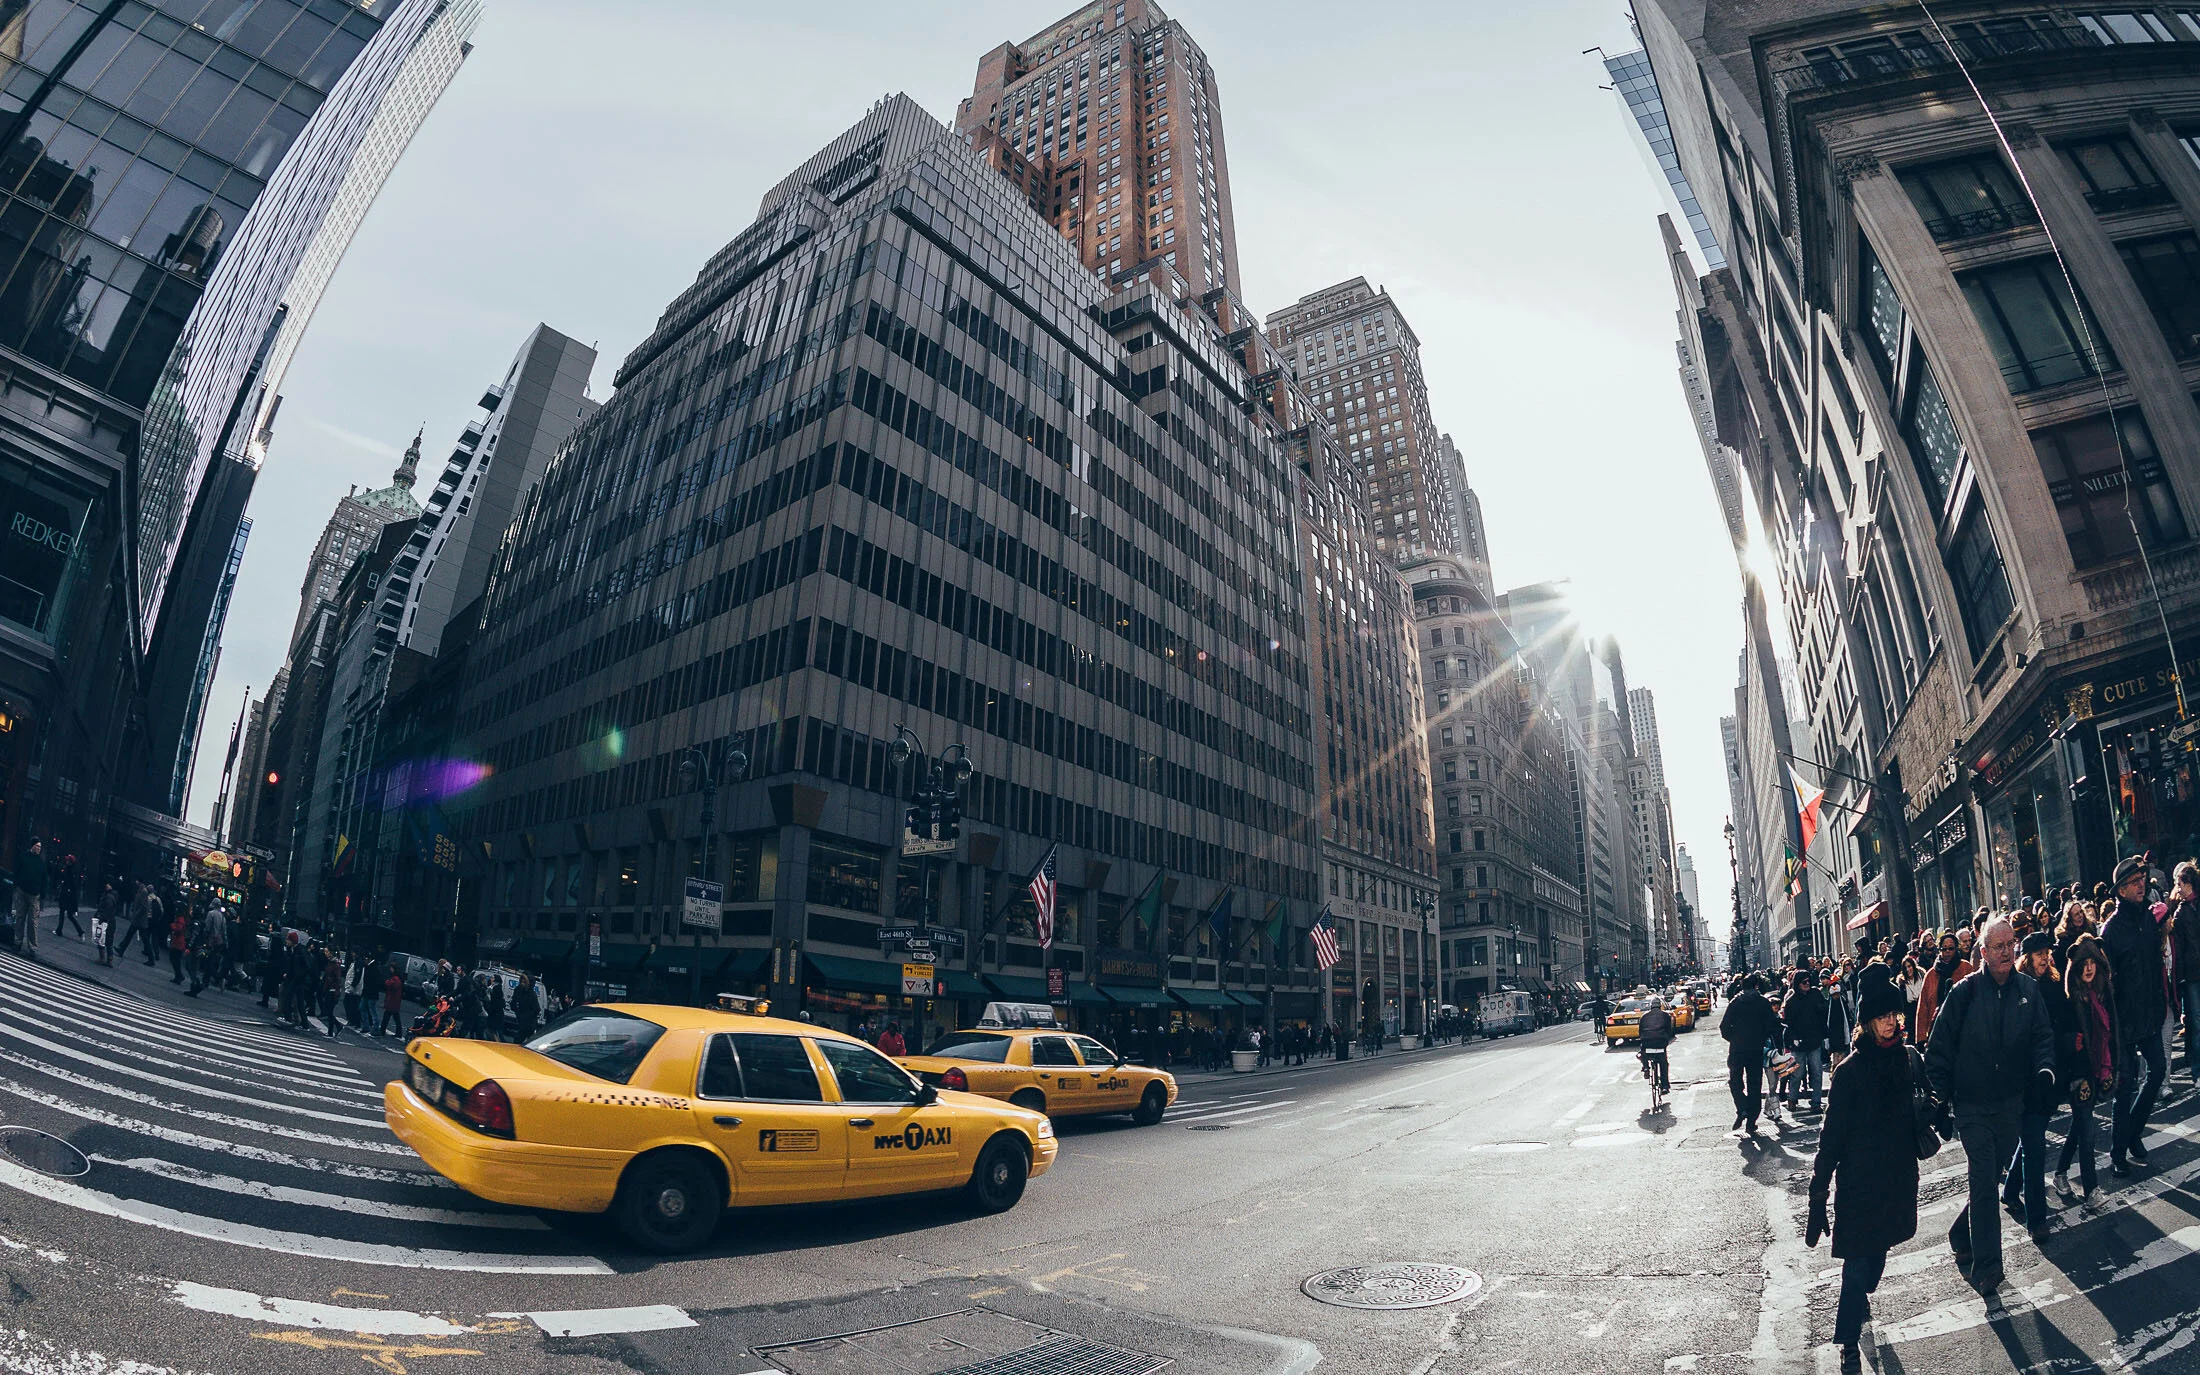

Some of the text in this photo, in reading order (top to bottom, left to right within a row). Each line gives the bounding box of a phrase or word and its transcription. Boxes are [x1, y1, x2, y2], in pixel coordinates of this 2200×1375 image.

[11, 511, 79, 559] REDKEN
[2104, 676, 2148, 703] CUTE
[2172, 727, 2185, 740] ONE
[705, 884, 722, 892] STREET
[699, 899, 716, 907] TURNS
[1342, 903, 1354, 915] THE
[893, 930, 905, 938] 46th
[905, 930, 912, 938] St
[934, 932, 958, 943] Fifth Ave
[874, 1122, 952, 1151] NYC TAXI
